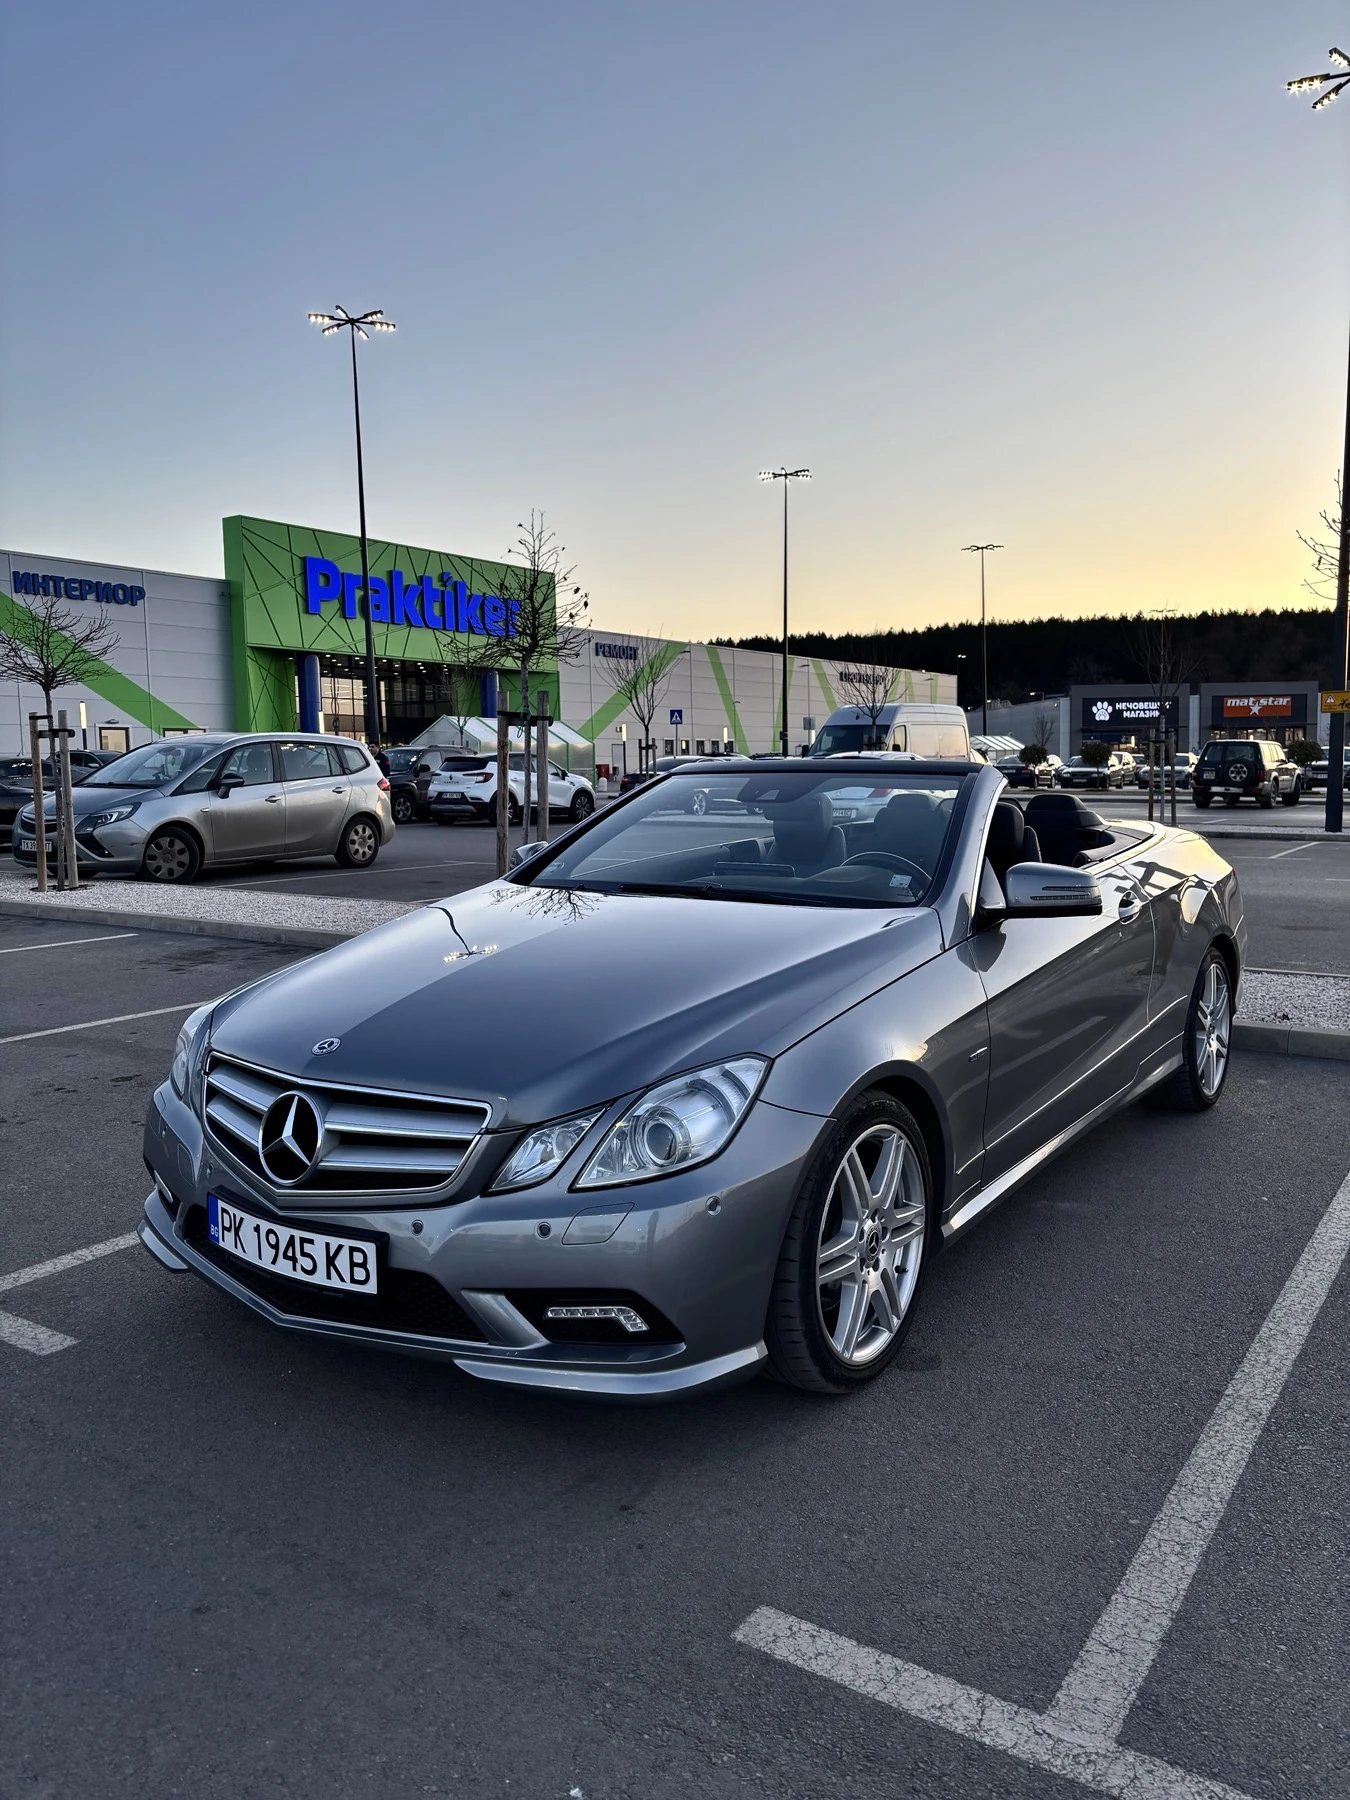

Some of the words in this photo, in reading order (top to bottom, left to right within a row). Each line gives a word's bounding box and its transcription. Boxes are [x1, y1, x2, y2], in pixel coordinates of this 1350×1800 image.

[12, 570, 146, 607] ИНТЕРИОР
[303, 555, 521, 638] Praktiker
[594, 641, 639, 661] РЕМОНТ
[1259, 697, 1291, 706] star
[210, 1224, 219, 1238] BG
[220, 1206, 247, 1254] PK
[253, 1223, 318, 1276] 1945
[324, 1241, 371, 1285] KB
